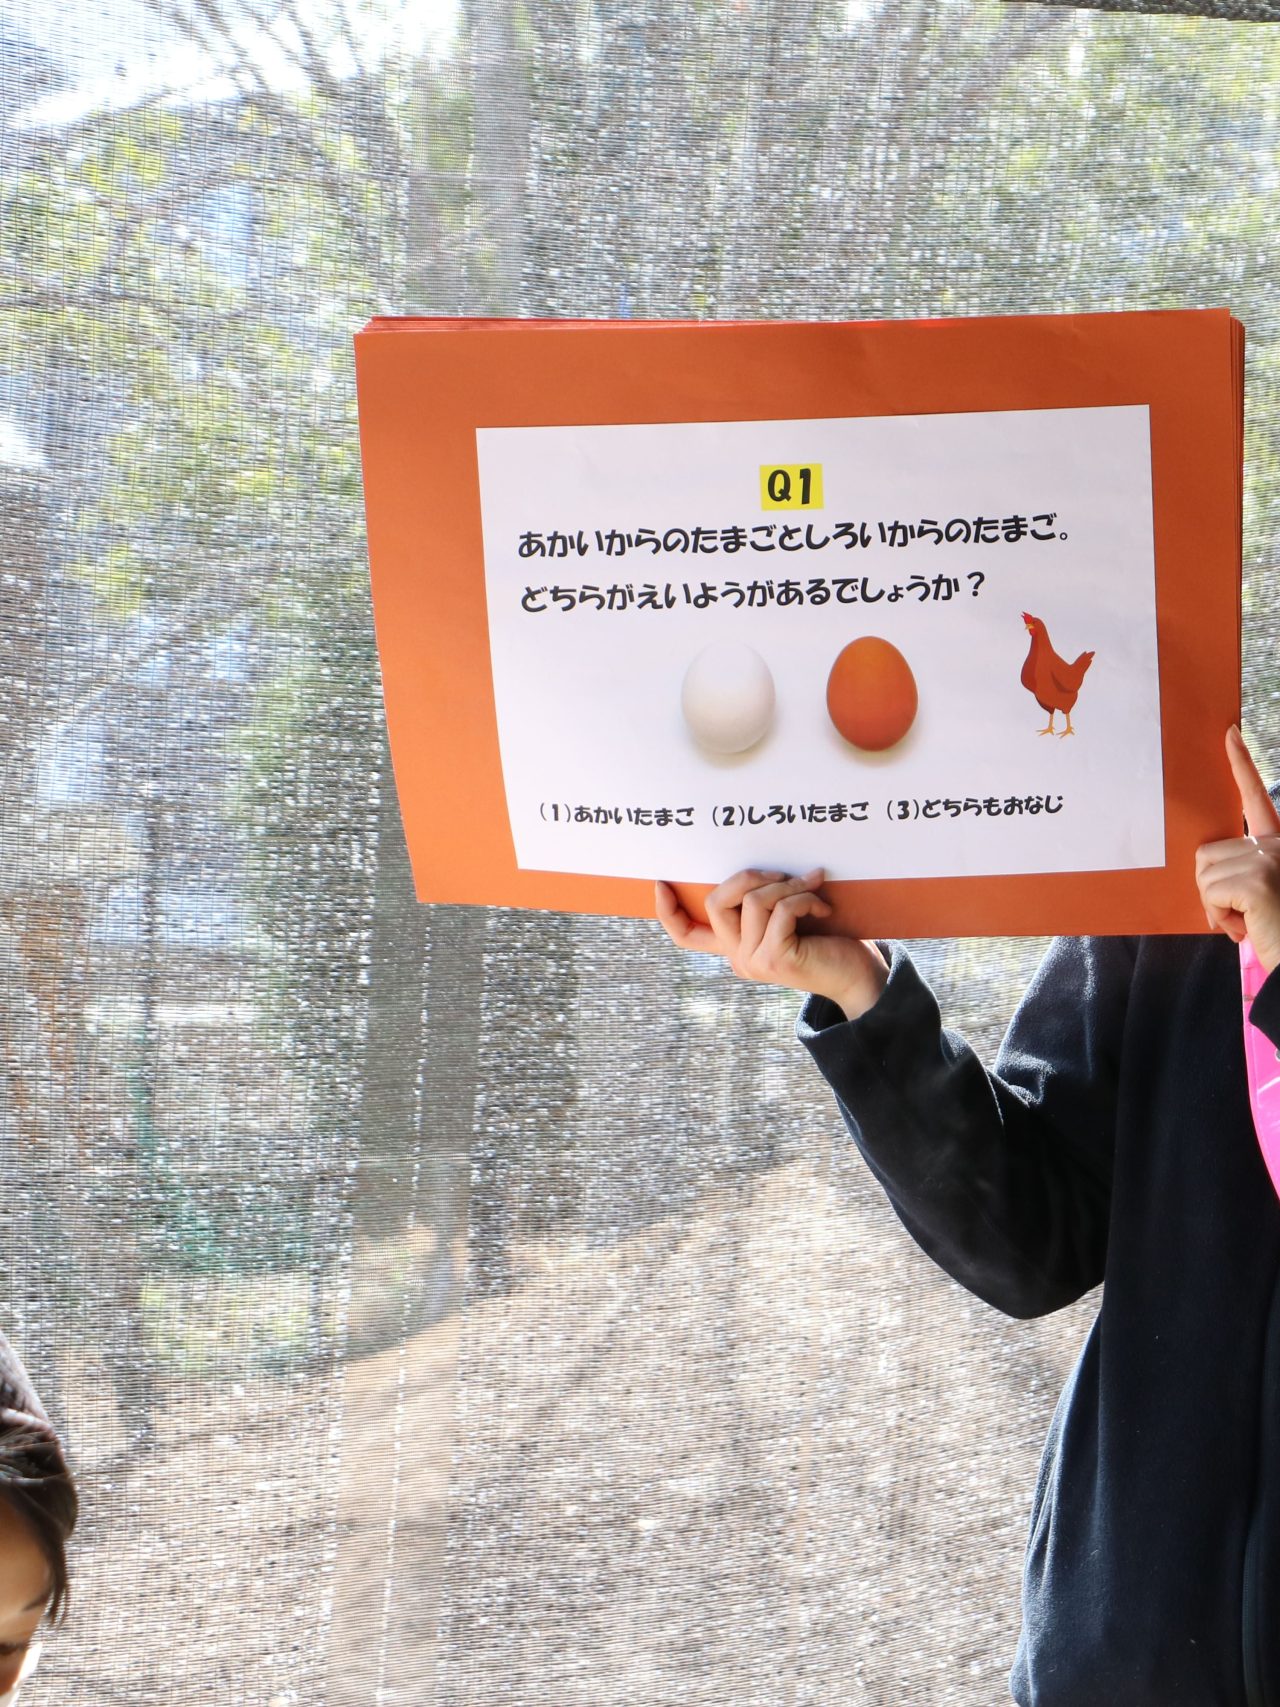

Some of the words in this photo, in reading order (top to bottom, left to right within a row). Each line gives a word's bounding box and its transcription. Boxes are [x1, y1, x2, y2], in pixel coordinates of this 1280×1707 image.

[767, 468, 812, 505] Q1
[517, 512, 1070, 559] あかいからのたまごとしろいからのたまご。
[520, 571, 985, 613] どちらがえいようがあるでしょうか？
